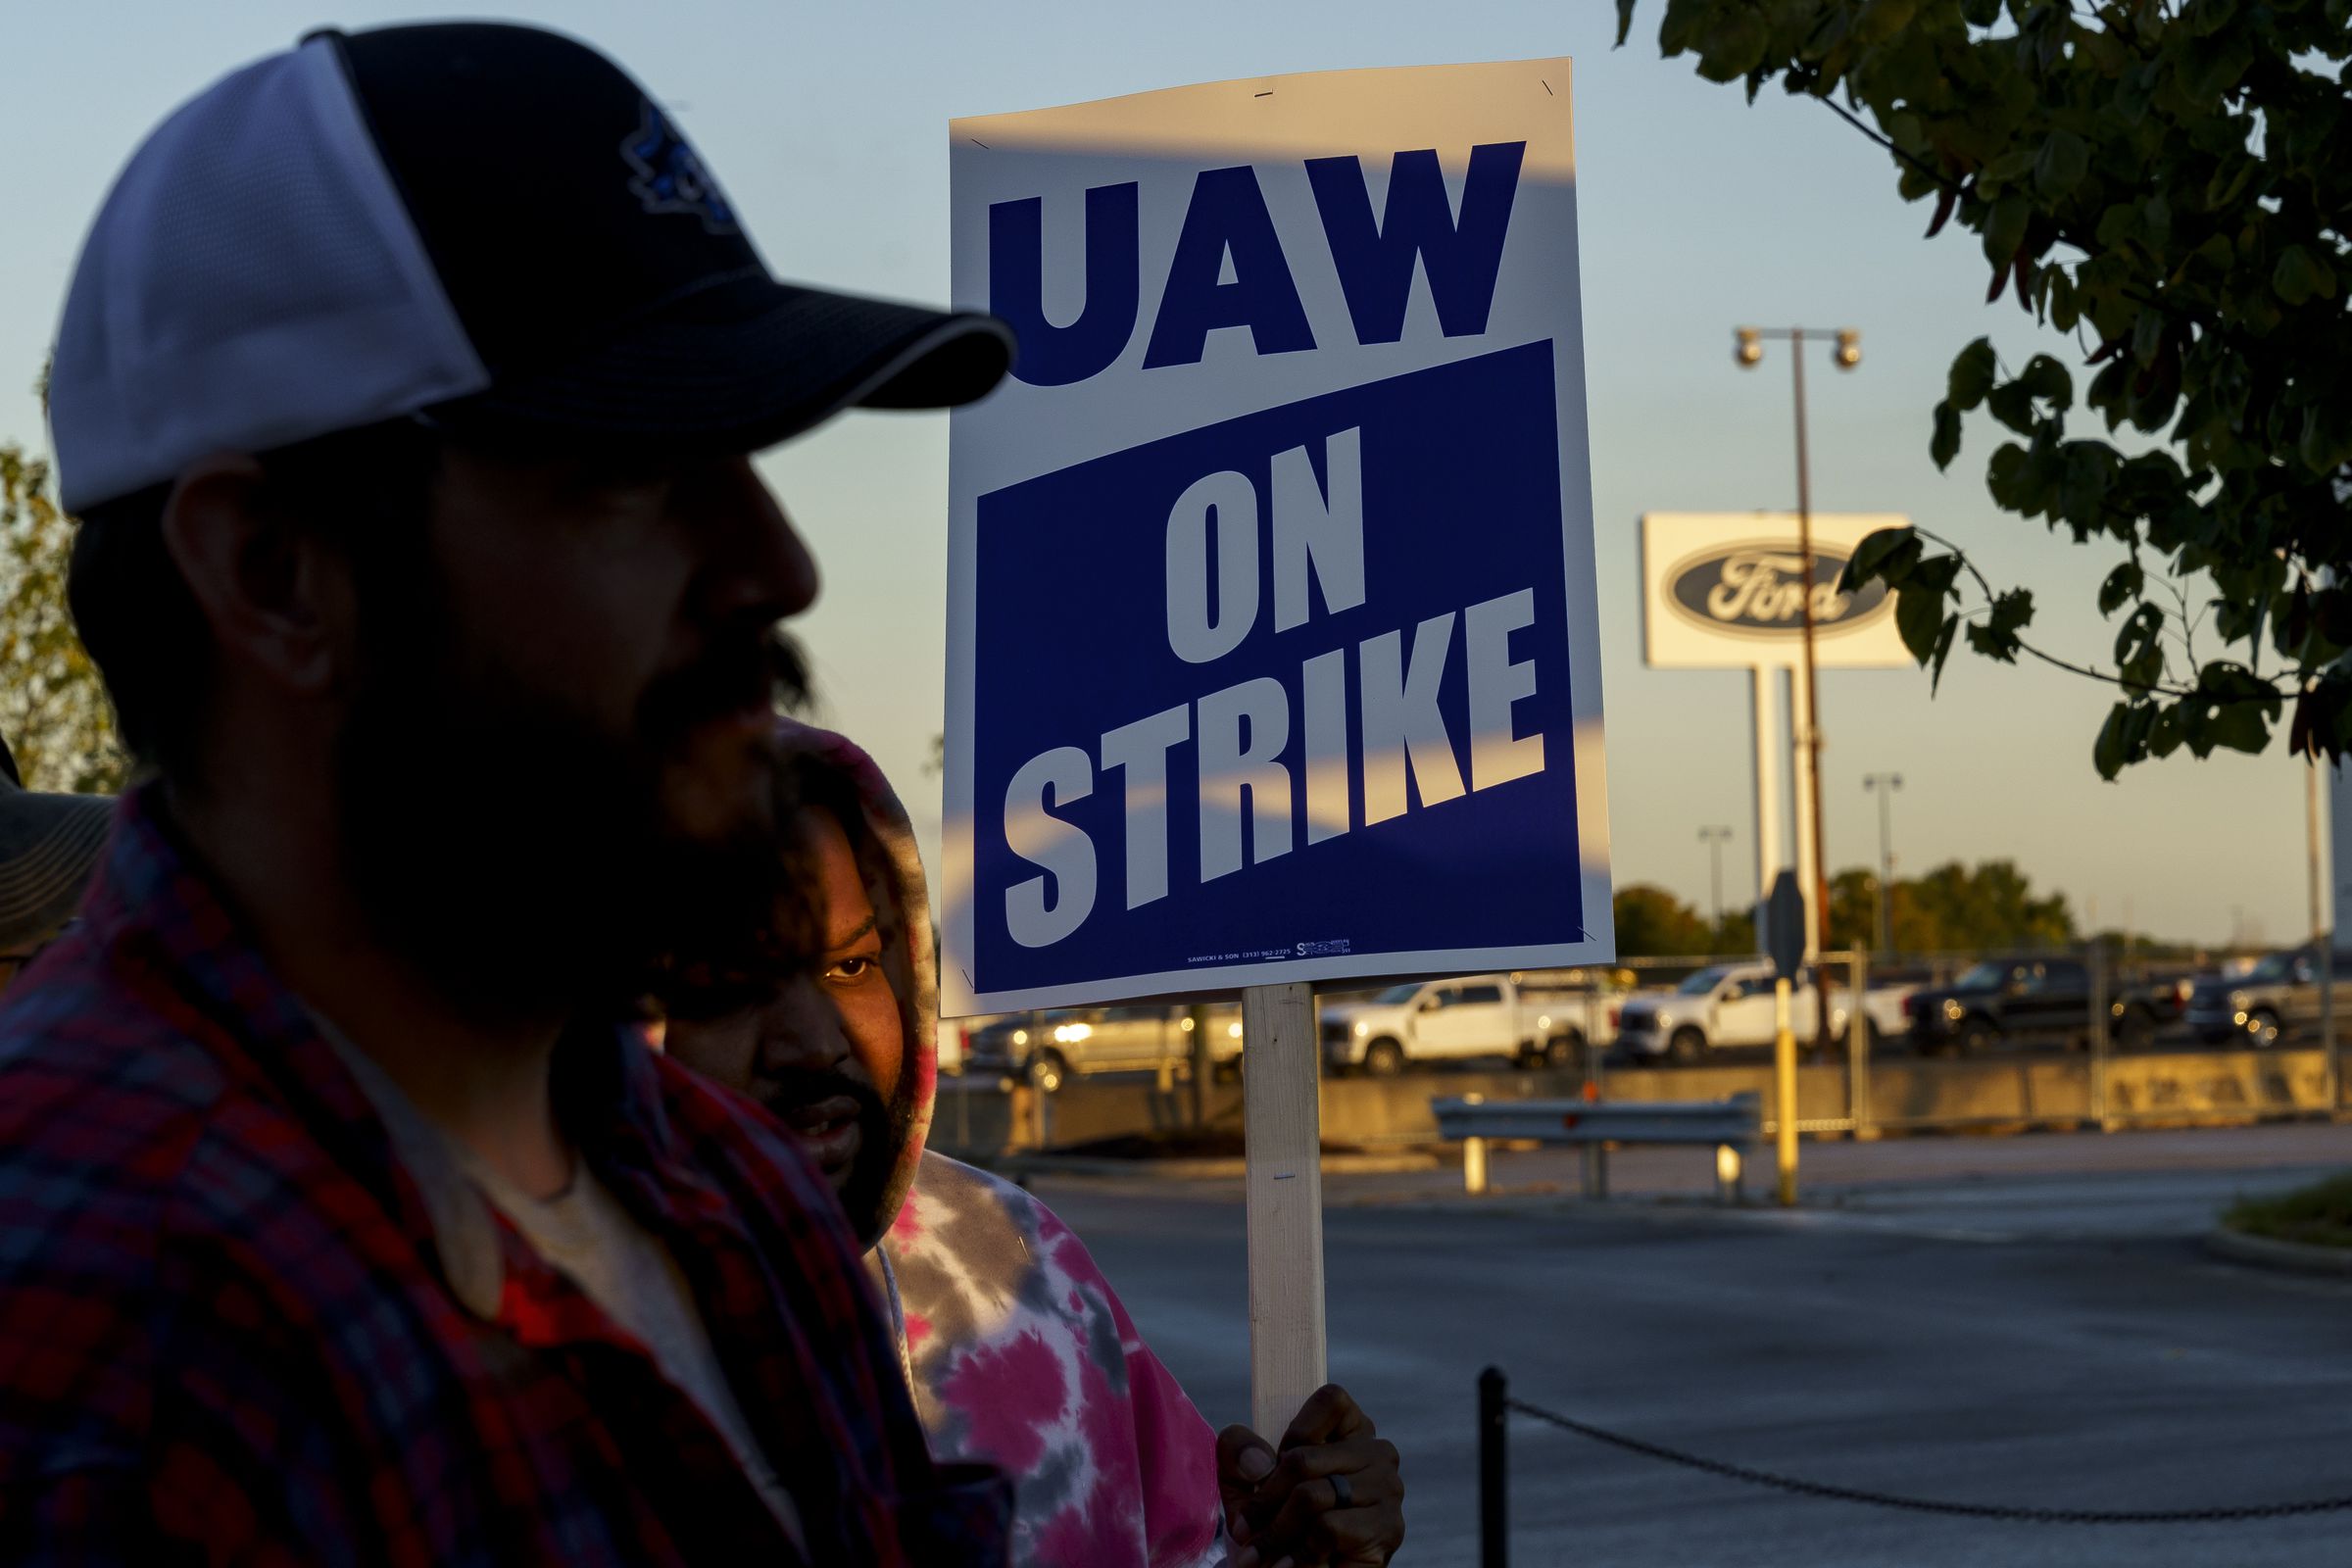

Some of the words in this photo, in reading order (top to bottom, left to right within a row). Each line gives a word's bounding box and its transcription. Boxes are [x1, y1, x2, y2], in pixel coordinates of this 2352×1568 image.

[989, 140, 1527, 387] UAW
[1166, 425, 1366, 663] ON
[1707, 550, 1850, 621] Ford
[1004, 587, 1545, 948] STRIKE
[1187, 955, 1216, 963] SAWICKI
